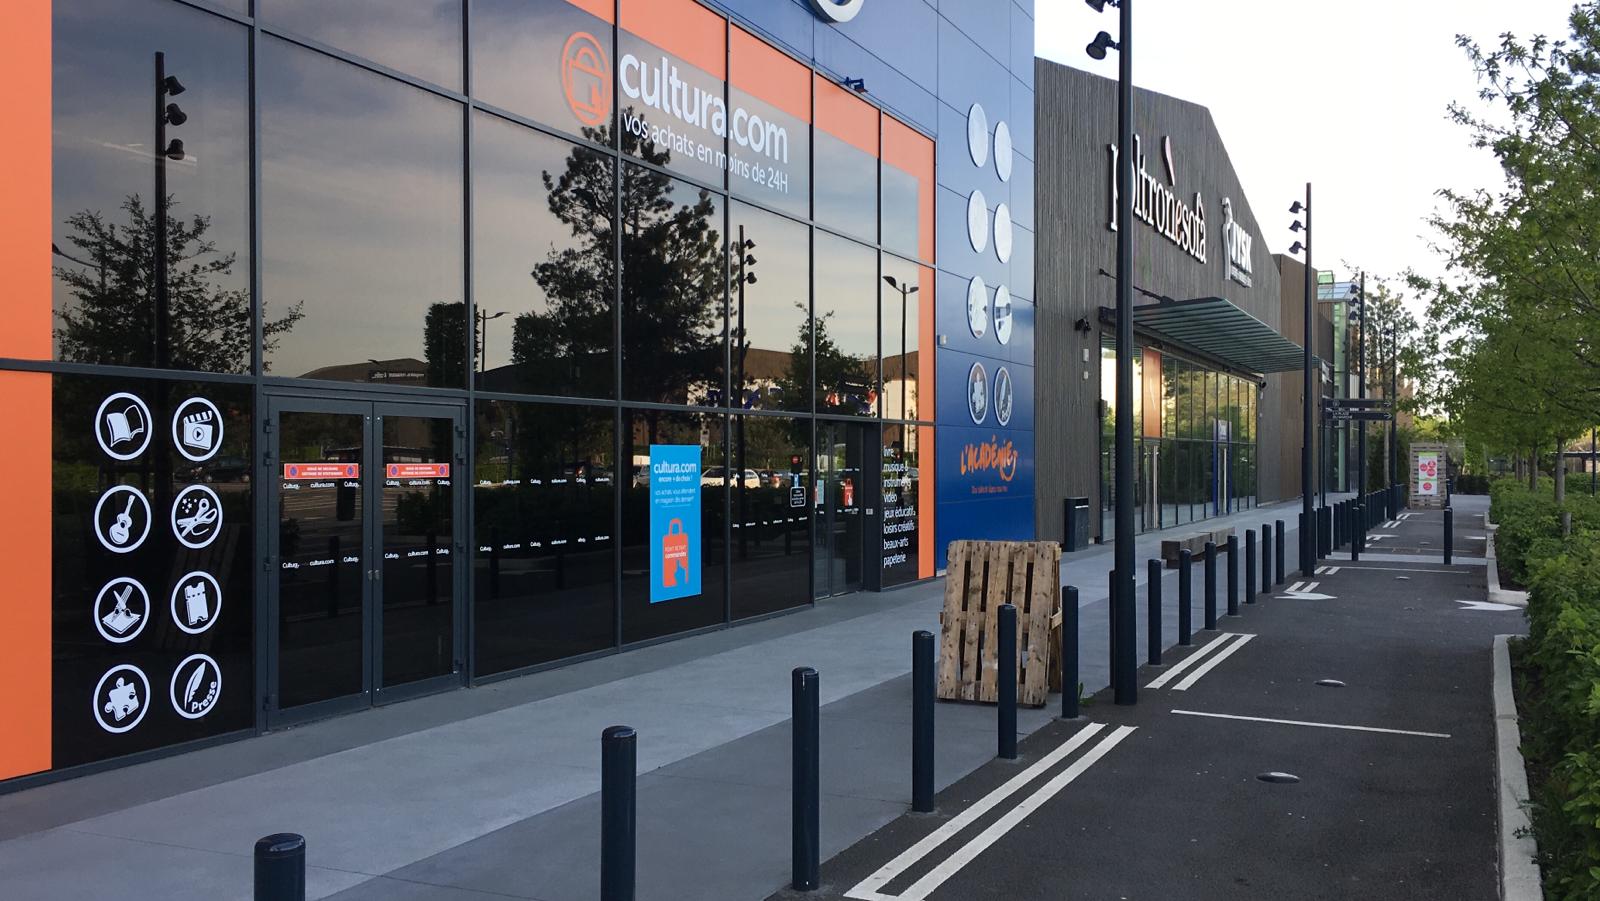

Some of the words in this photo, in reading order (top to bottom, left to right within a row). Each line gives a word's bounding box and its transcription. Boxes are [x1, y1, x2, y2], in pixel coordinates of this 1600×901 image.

[619, 53, 789, 164] cultura.com
[623, 112, 649, 139] vos
[651, 123, 694, 156] achats
[697, 143, 713, 162] en
[751, 162, 766, 185] de
[767, 166, 788, 193] 24H
[883, 446, 895, 458] livre
[654, 460, 697, 474] cultura.com
[883, 461, 904, 474] musique
[883, 491, 898, 503] vidéo
[883, 507, 895, 522] jeux
[883, 523, 898, 535] loisirs
[898, 519, 915, 532] créatifs
[883, 537, 909, 550] beaux-arts
[883, 551, 907, 569] papeterie
[191, 681, 217, 713] Presse
